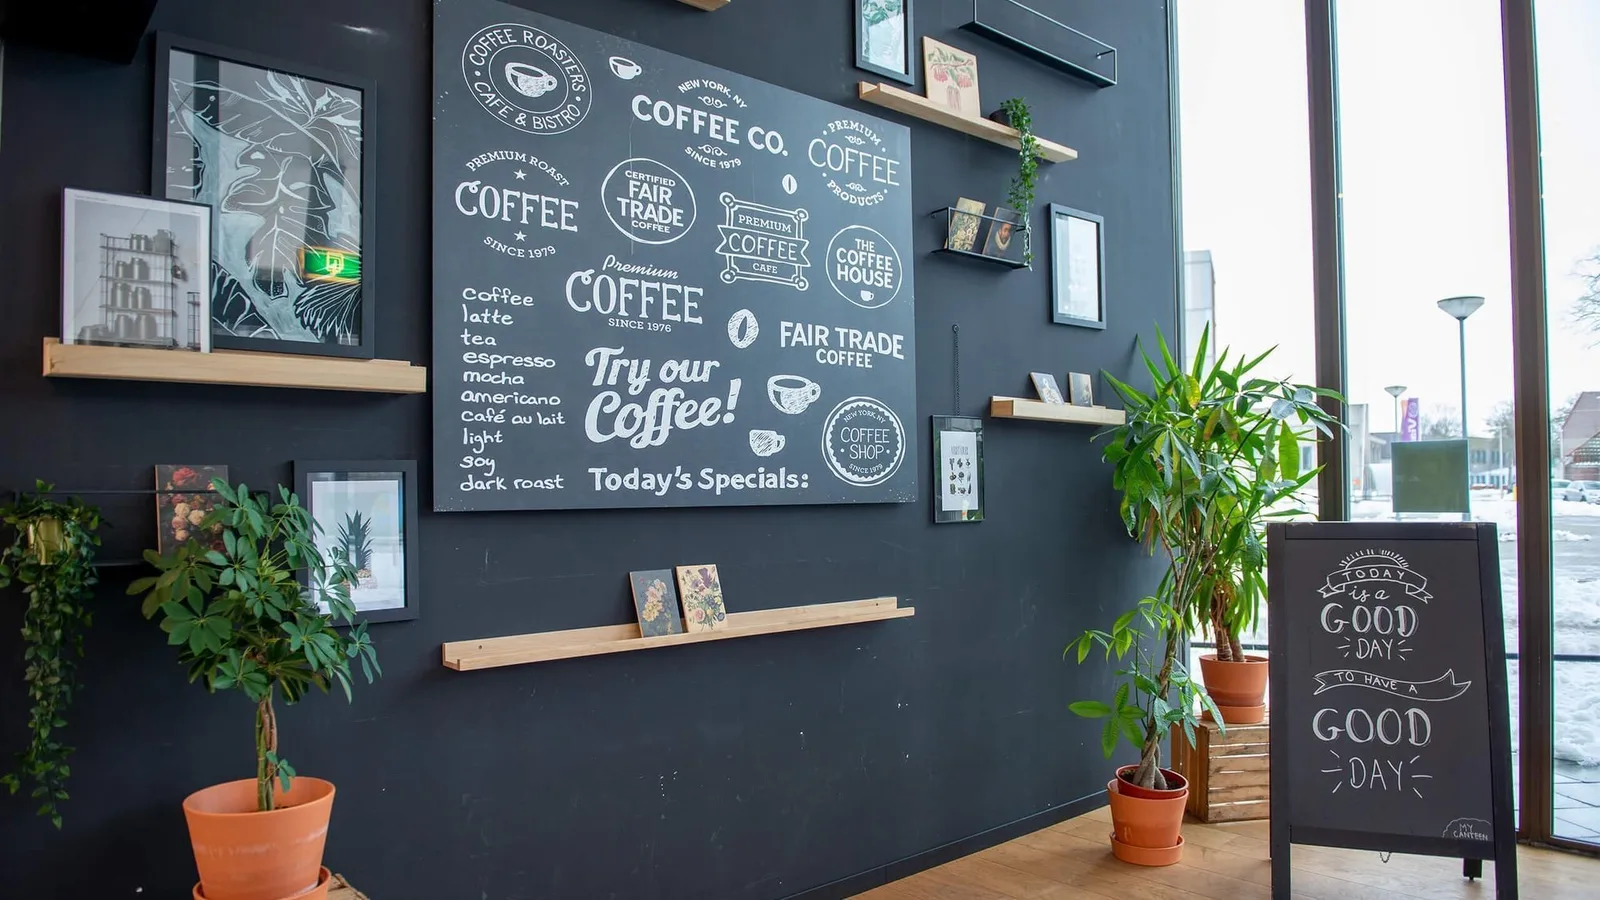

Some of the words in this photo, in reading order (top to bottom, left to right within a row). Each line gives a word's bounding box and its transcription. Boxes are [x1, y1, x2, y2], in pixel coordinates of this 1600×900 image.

[469, 29, 517, 66] COFFEE
[523, 30, 586, 93] ROASTERS
[474, 82, 513, 118] CAFE
[515, 113, 527, 126] &
[532, 104, 581, 129] BISTRO
[678, 79, 700, 94] NEW
[702, 80, 731, 98] YORK,
[733, 93, 747, 109] NY
[631, 94, 740, 145] COFFEE
[747, 126, 788, 156] CO.
[827, 120, 882, 147] PREMIUM
[466, 151, 527, 171] PREMIUM
[529, 156, 569, 187] ROAST
[685, 147, 717, 168] SINCE
[719, 158, 741, 170] 1979
[808, 138, 900, 186] COFFEE
[625, 170, 675, 187] CERTIFIED
[629, 180, 672, 205] FAIR
[827, 180, 884, 206] PRODUCTS
[455, 180, 579, 232] COFFEE
[617, 197, 684, 227] TRADE
[631, 220, 671, 234] COFFEE
[738, 214, 791, 233] PREMIUM
[484, 236, 525, 258] SINCE
[529, 245, 556, 258] 1979
[728, 233, 797, 261] COFFEE
[855, 238, 875, 253] THE
[603, 255, 679, 279] Premium
[752, 262, 778, 274] CAFE
[836, 248, 893, 272] COFFEE
[837, 264, 893, 289] HOUSE
[566, 269, 704, 324] COFFEE
[463, 304, 514, 325] latte
[608, 318, 644, 330] SINCE
[647, 322, 672, 333] 1976
[461, 329, 497, 346] tea
[780, 320, 829, 348] FAIR
[834, 327, 904, 360] TRADE
[463, 352, 556, 369] espresso
[816, 348, 872, 368] COFFEE
[463, 371, 524, 385] mocha
[585, 346, 650, 396] Try
[658, 359, 720, 383] our
[461, 390, 561, 405] americano
[511, 415, 532, 425] au
[538, 412, 566, 425] lait
[585, 378, 742, 449] Coffee!
[843, 411, 857, 423] NEW
[876, 415, 886, 424] NY
[463, 428, 503, 454] light
[840, 427, 890, 443] COFFEE
[849, 444, 884, 460] SHOP
[460, 456, 496, 476] soy
[849, 463, 868, 473] SINCE
[460, 475, 506, 491] dark
[513, 474, 564, 490] roast
[588, 466, 693, 496] Today's
[697, 467, 809, 495] Specials:
[1341, 569, 1405, 582] TODAY
[1349, 586, 1370, 602] is
[1375, 588, 1390, 601] a
[1320, 602, 1419, 637] GOOD
[1357, 638, 1394, 660] DAY
[1334, 671, 1355, 682] TO
[1364, 675, 1398, 691] HAVE
[1408, 683, 1418, 694] A
[1312, 708, 1432, 747] GOOD
[1349, 756, 1403, 791] DAY
[1453, 830, 1488, 841] CANTEEN
[1459, 823, 1473, 832] MY
